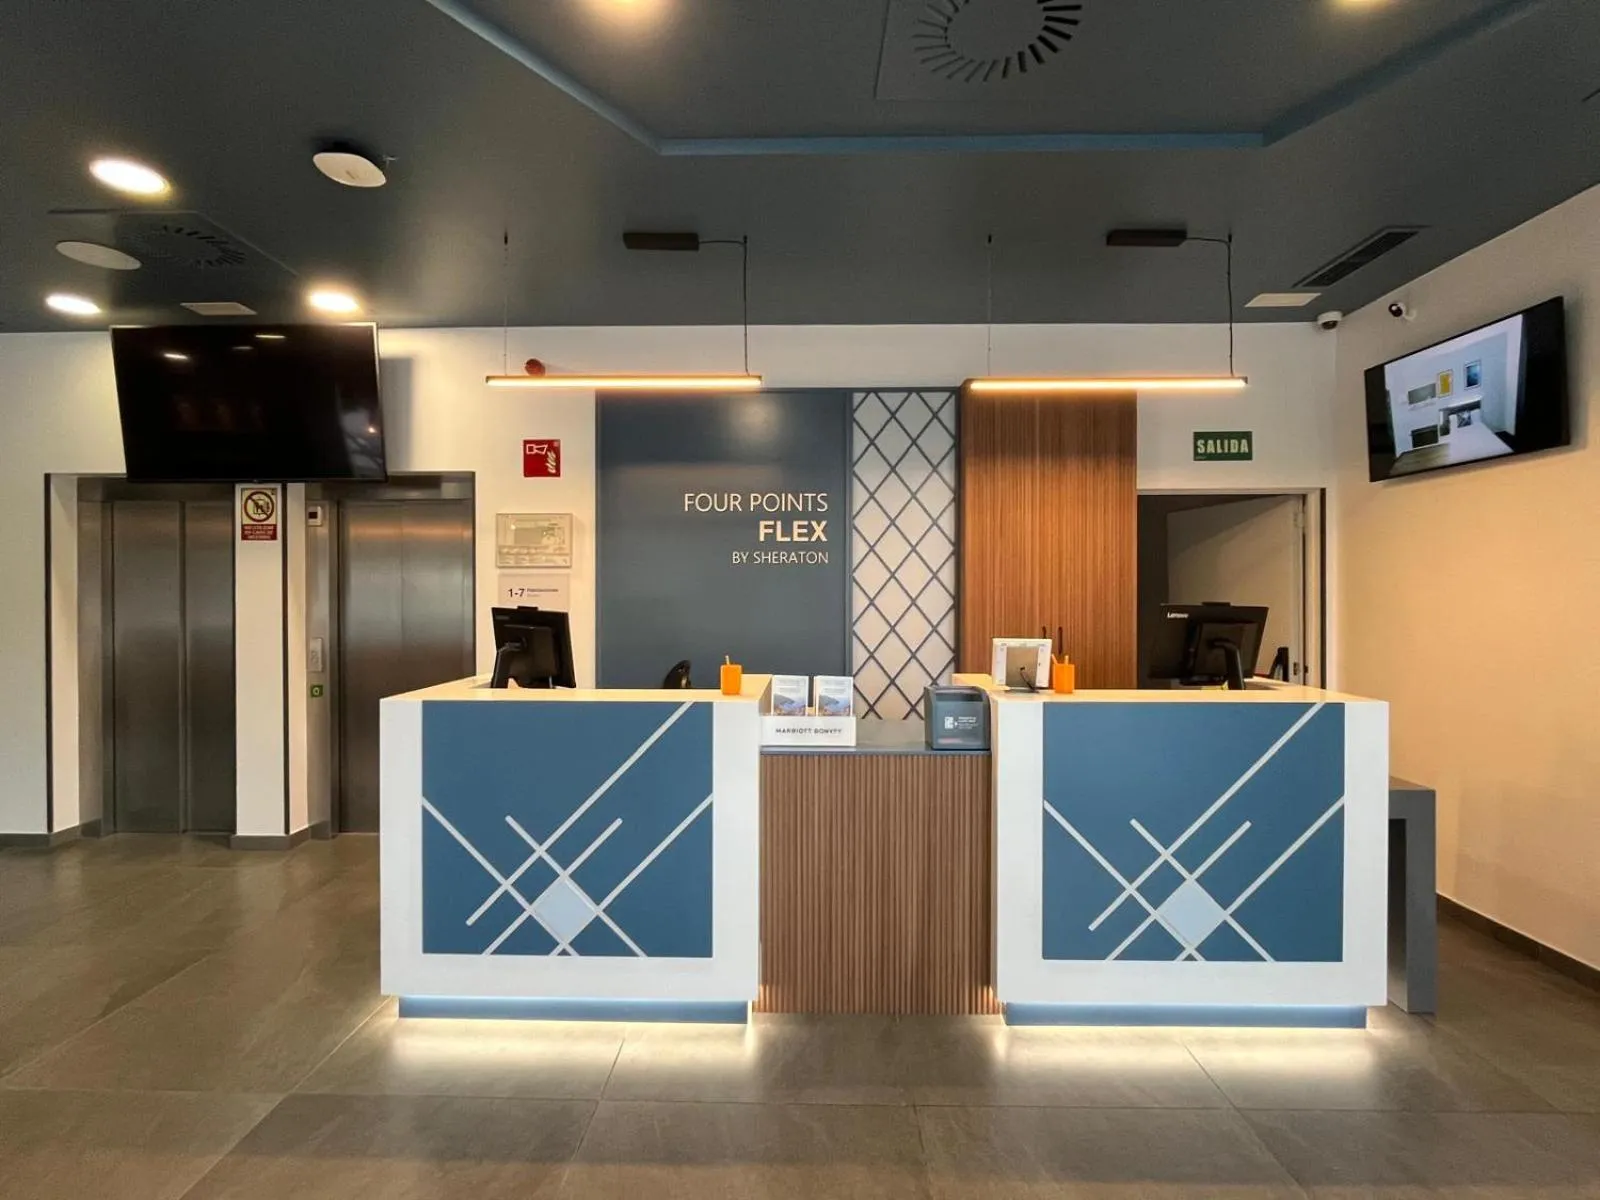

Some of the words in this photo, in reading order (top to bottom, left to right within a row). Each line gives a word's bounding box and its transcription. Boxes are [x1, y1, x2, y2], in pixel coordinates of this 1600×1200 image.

[1197, 439, 1249, 454] SALIDA
[684, 493, 742, 512] FOUR
[750, 493, 828, 512] POINTS
[759, 520, 828, 542] FLEX
[732, 551, 749, 564] BY
[753, 551, 829, 564] SHERATON
[507, 588, 525, 598] 1-7
